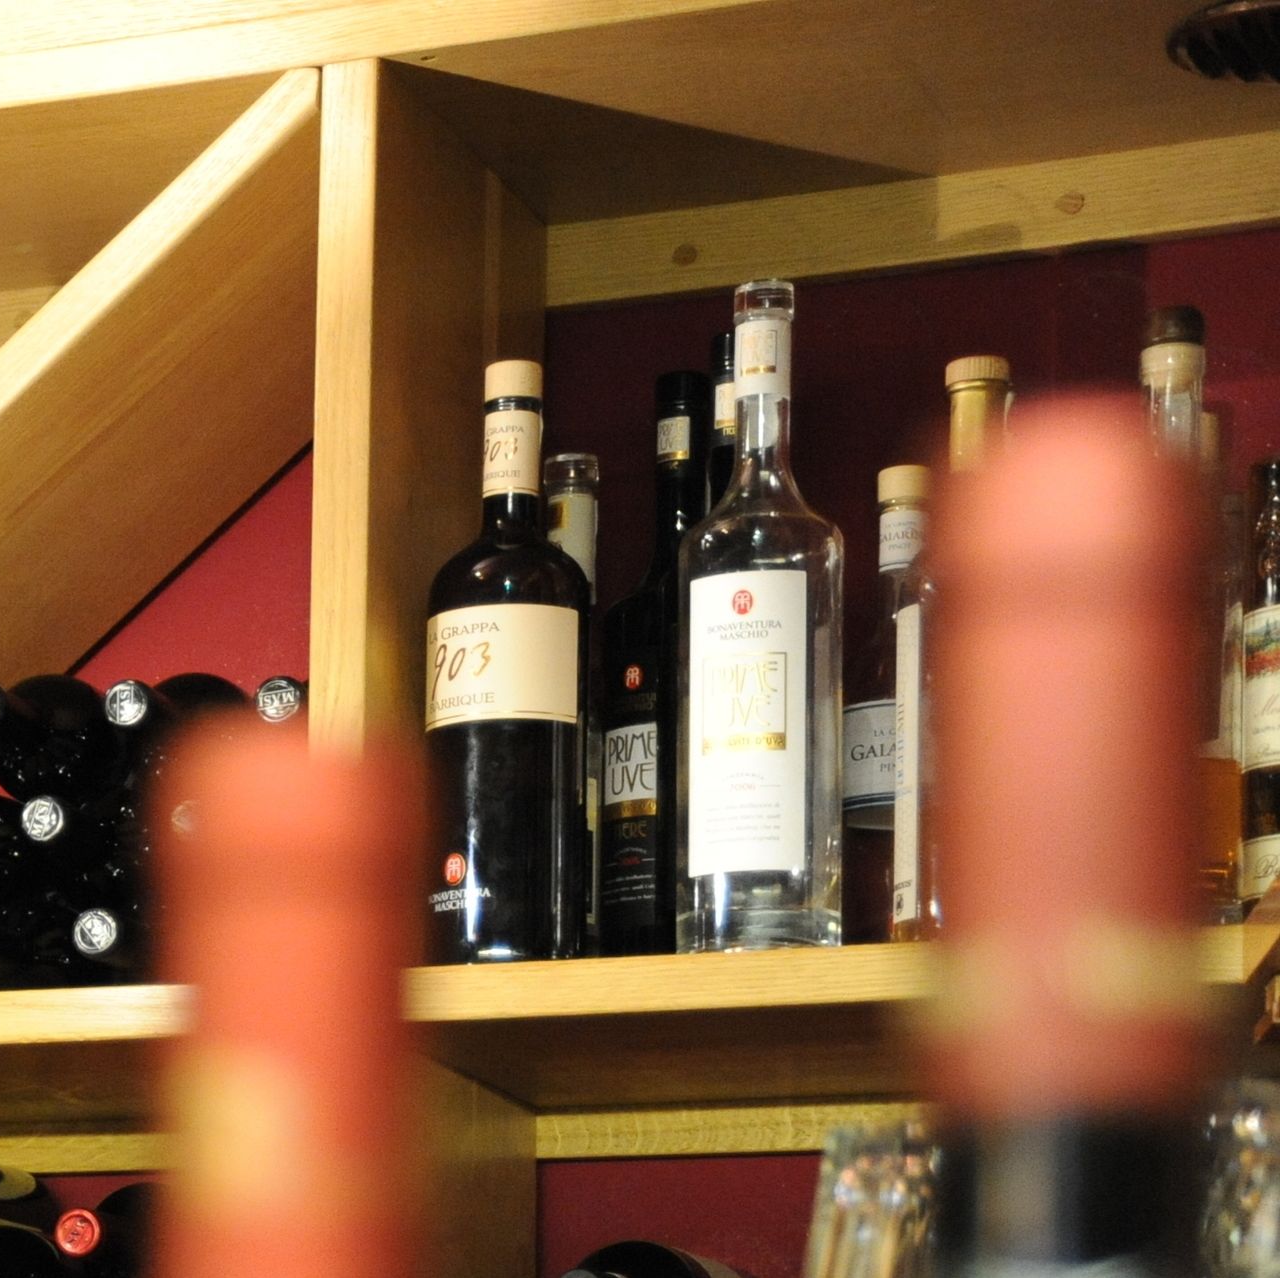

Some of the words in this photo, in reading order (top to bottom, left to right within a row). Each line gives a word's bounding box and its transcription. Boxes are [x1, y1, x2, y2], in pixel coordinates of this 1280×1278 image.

[441, 621, 501, 641] GRAPPA
[707, 619, 782, 634] BONAVENTURA
[720, 629, 769, 641] MASCHIO
[431, 642, 492, 702] 903
[261, 690, 294, 708] MASI
[608, 729, 657, 766] PRIME
[611, 761, 654, 795] UVE
[428, 887, 491, 905] ONAVENTRA
